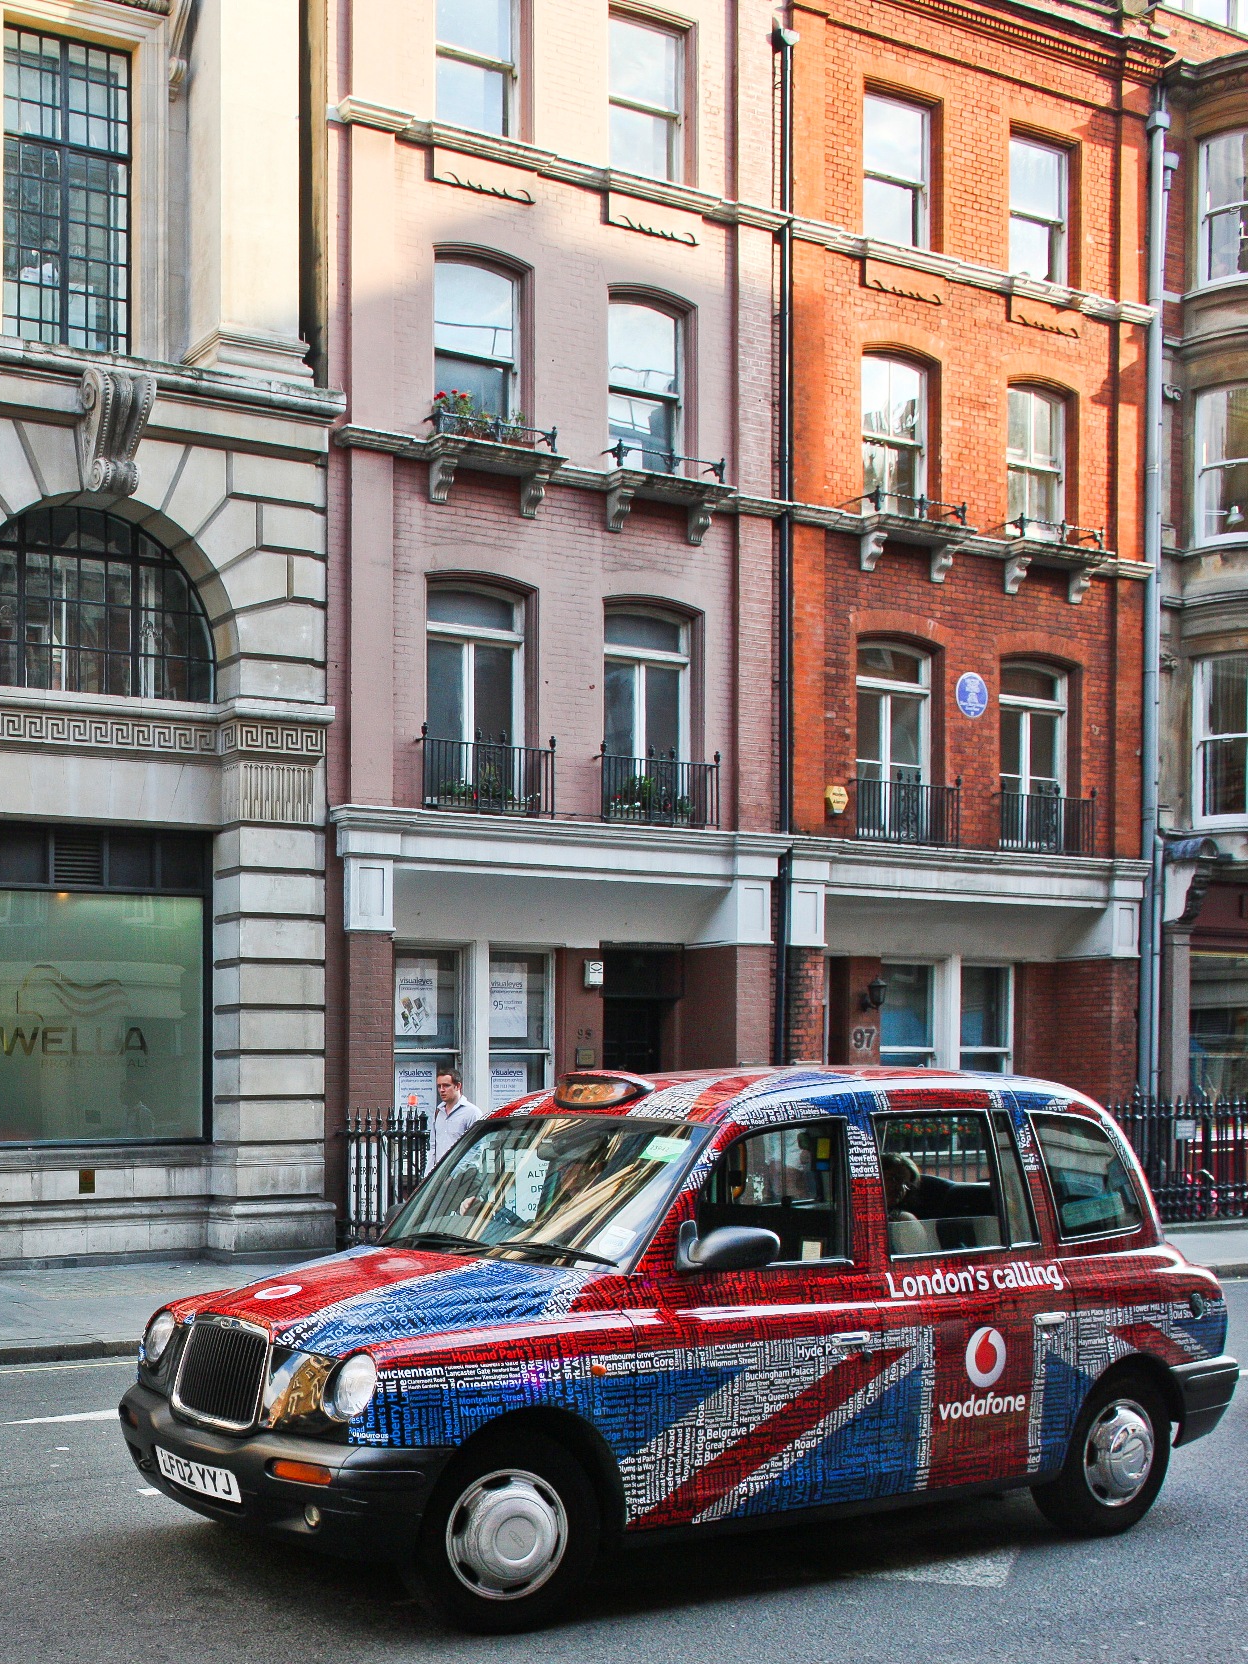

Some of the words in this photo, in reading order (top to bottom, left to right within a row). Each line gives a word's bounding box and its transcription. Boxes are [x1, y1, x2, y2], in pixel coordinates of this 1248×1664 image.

[399, 976, 433, 985] visualeyes
[490, 980, 523, 989] visualeyes
[492, 1000, 504, 1011] 95
[852, 1027, 875, 1049] 97
[398, 1069, 433, 1077] visualeyes
[491, 1069, 524, 1077] visualeyes
[885, 1265, 990, 1298] London's
[992, 1261, 1064, 1291] calling
[327, 1302, 385, 1341] Tottenham
[385, 1303, 421, 1336] Oxford
[1173, 1310, 1183, 1320] Old
[701, 1322, 753, 1333] Paddington
[529, 1336, 557, 1346] Corner
[577, 1343, 616, 1352] Portobello
[616, 1341, 635, 1350] Road
[1078, 1335, 1107, 1346] Haymarket
[797, 1345, 823, 1360] Hyde
[922, 1328, 930, 1368] Seymour
[452, 1349, 498, 1363] Holland
[498, 1347, 525, 1359] Park
[598, 1352, 636, 1361] Westbourne
[636, 1351, 655, 1359] Grove
[738, 1357, 758, 1365] Street
[601, 1360, 652, 1372] Kensington
[652, 1357, 674, 1367] Gore
[376, 1367, 445, 1380] wickenham
[445, 1369, 476, 1377] Lancaster
[744, 1369, 790, 1381] Buckingham
[791, 1366, 815, 1376] Palace
[386, 1380, 398, 1402] Hill
[456, 1379, 522, 1391] Queensway
[400, 1379, 409, 1405] Lane
[442, 1383, 450, 1407] Road
[755, 1395, 767, 1403] The
[767, 1391, 794, 1402] Queen's
[458, 1395, 500, 1406] Montpelier
[501, 1393, 524, 1402] Street
[939, 1391, 1026, 1421] vodafone
[460, 1404, 503, 1417] Notting
[602, 1407, 629, 1415] Thurloe
[696, 1397, 705, 1427] Road
[763, 1401, 793, 1414] Bridge
[444, 1409, 453, 1438] Heath
[740, 1414, 761, 1424] Herrick
[920, 1413, 928, 1438] Place
[706, 1427, 748, 1440] Belgrave
[667, 1429, 676, 1455] Road
[683, 1427, 692, 1454] Mews
[705, 1440, 726, 1450] Great
[794, 1438, 817, 1450] Road
[695, 1429, 707, 1467] Bridge
[919, 1438, 928, 1467] Hobart
[642, 1455, 656, 1464] Park
[160, 1448, 196, 1486] LF02
[196, 1466, 232, 1496] YYJ
[643, 1463, 656, 1472] Way
[682, 1455, 690, 1482] Royal
[746, 1473, 769, 1482] Hudson's
[794, 1450, 805, 1503] Victoria
